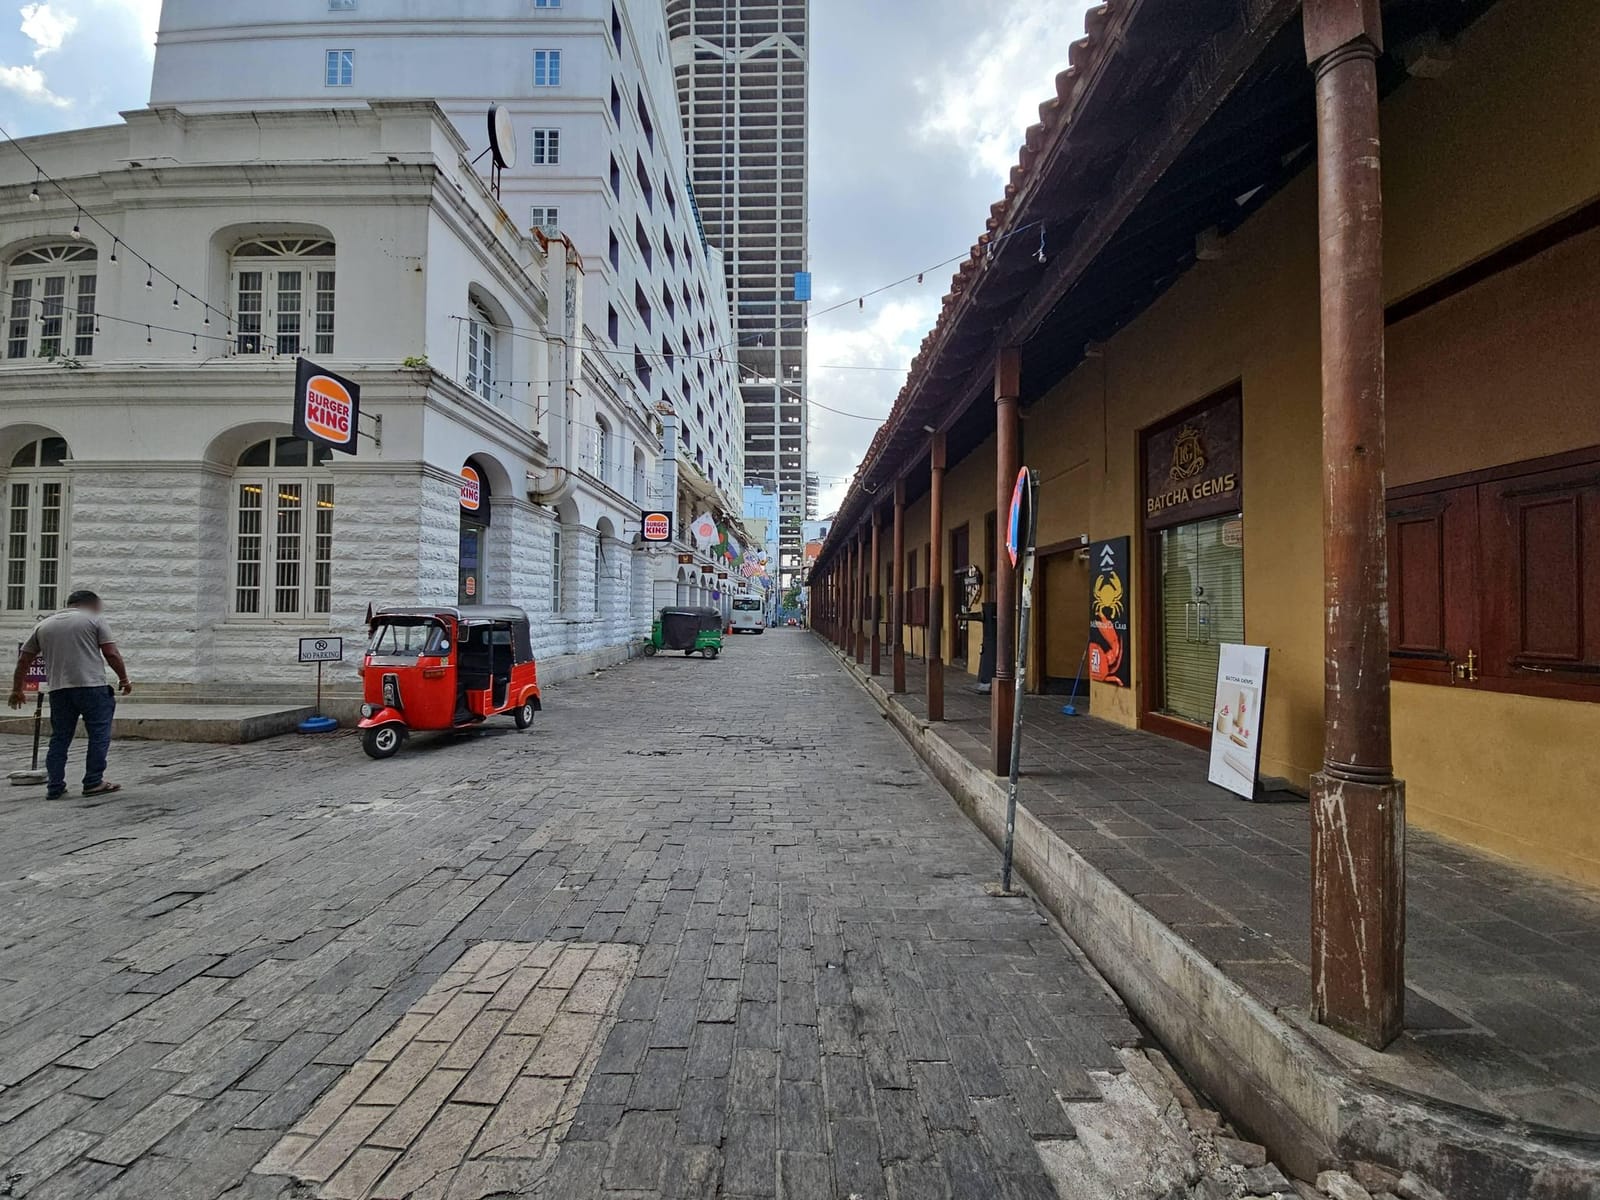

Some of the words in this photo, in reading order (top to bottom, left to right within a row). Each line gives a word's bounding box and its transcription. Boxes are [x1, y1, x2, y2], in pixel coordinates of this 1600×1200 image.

[308, 391, 350, 417] BURGER
[307, 403, 349, 433] KING
[460, 487, 479, 502] KING
[1147, 487, 1189, 513] BATCHA
[1192, 473, 1236, 500] GEMS
[302, 651, 312, 660] NO
[312, 650, 340, 660] PARKING
